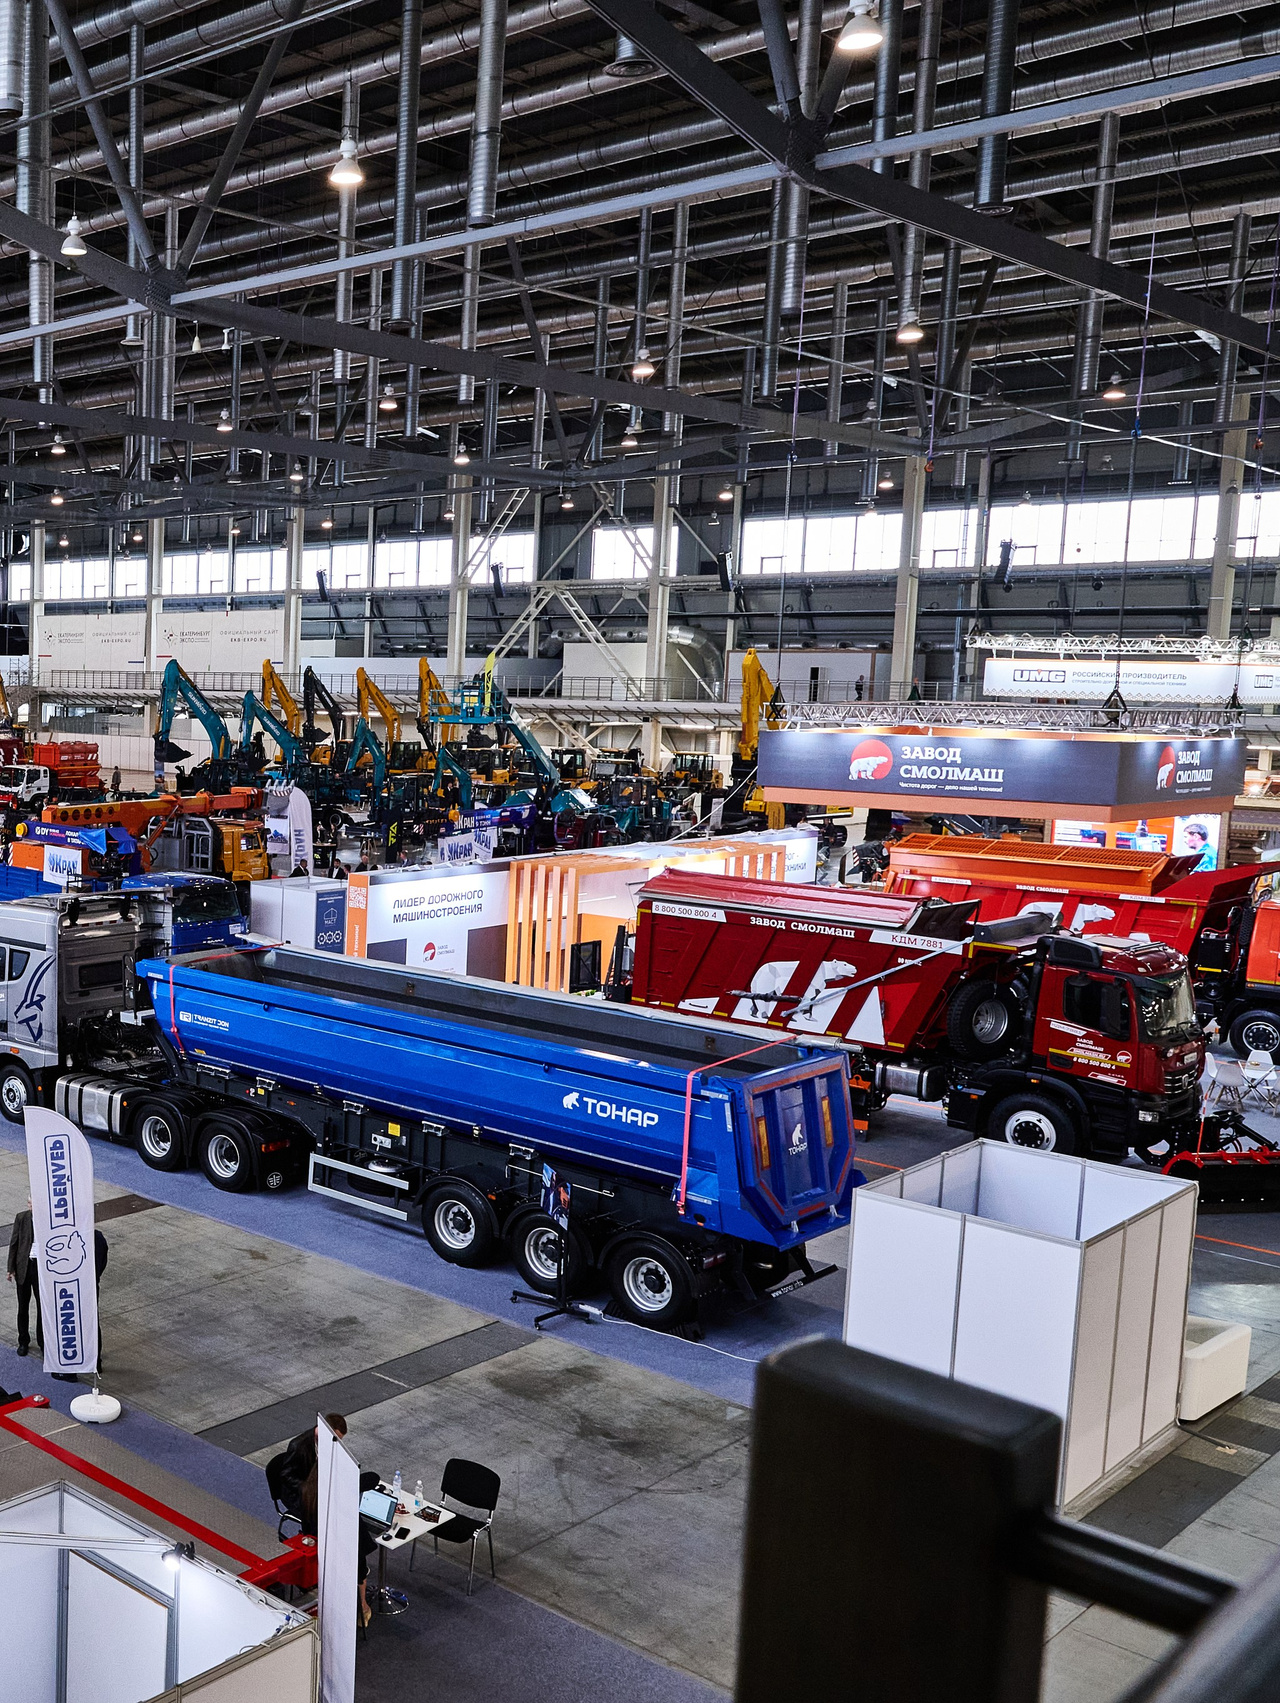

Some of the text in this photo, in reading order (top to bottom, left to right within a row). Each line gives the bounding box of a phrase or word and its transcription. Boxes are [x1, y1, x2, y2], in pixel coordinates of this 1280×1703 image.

[179, 630, 210, 638] ЕКАТЕРИНБУРГ
[1013, 669, 1066, 683] UMG
[1122, 672, 1187, 680] ПРОИЗВОДИТЕЛЬ
[1254, 674, 1273, 688] UMG
[900, 745, 962, 764] ЗАВОД
[1177, 750, 1201, 766] ЗАВОД
[899, 765, 1005, 783] СМОЛМАШ
[1176, 768, 1213, 784] СМОЛМАШ
[899, 781, 921, 789] Чистота
[959, 784, 978, 792] нашей
[1016, 884, 1070, 894] завод смолмаш
[393, 889, 484, 909] ЛИДЕР ДОРОЖНОГО
[392, 903, 483, 924] МАШИНОСТРОЕНИЯ
[661, 905, 676, 914] 800
[677, 907, 693, 915] 500
[694, 909, 709, 918] 800
[711, 911, 717, 919] 4
[750, 916, 855, 938] завод смолмаш
[891, 934, 944, 949] КДМ 7881
[1075, 1042, 1104, 1052] СМОЛМАШ
[1076, 1037, 1094, 1045] ЗАВОД
[582, 1096, 659, 1128] ТОНАР
[788, 1143, 808, 1156] ТОНАР
